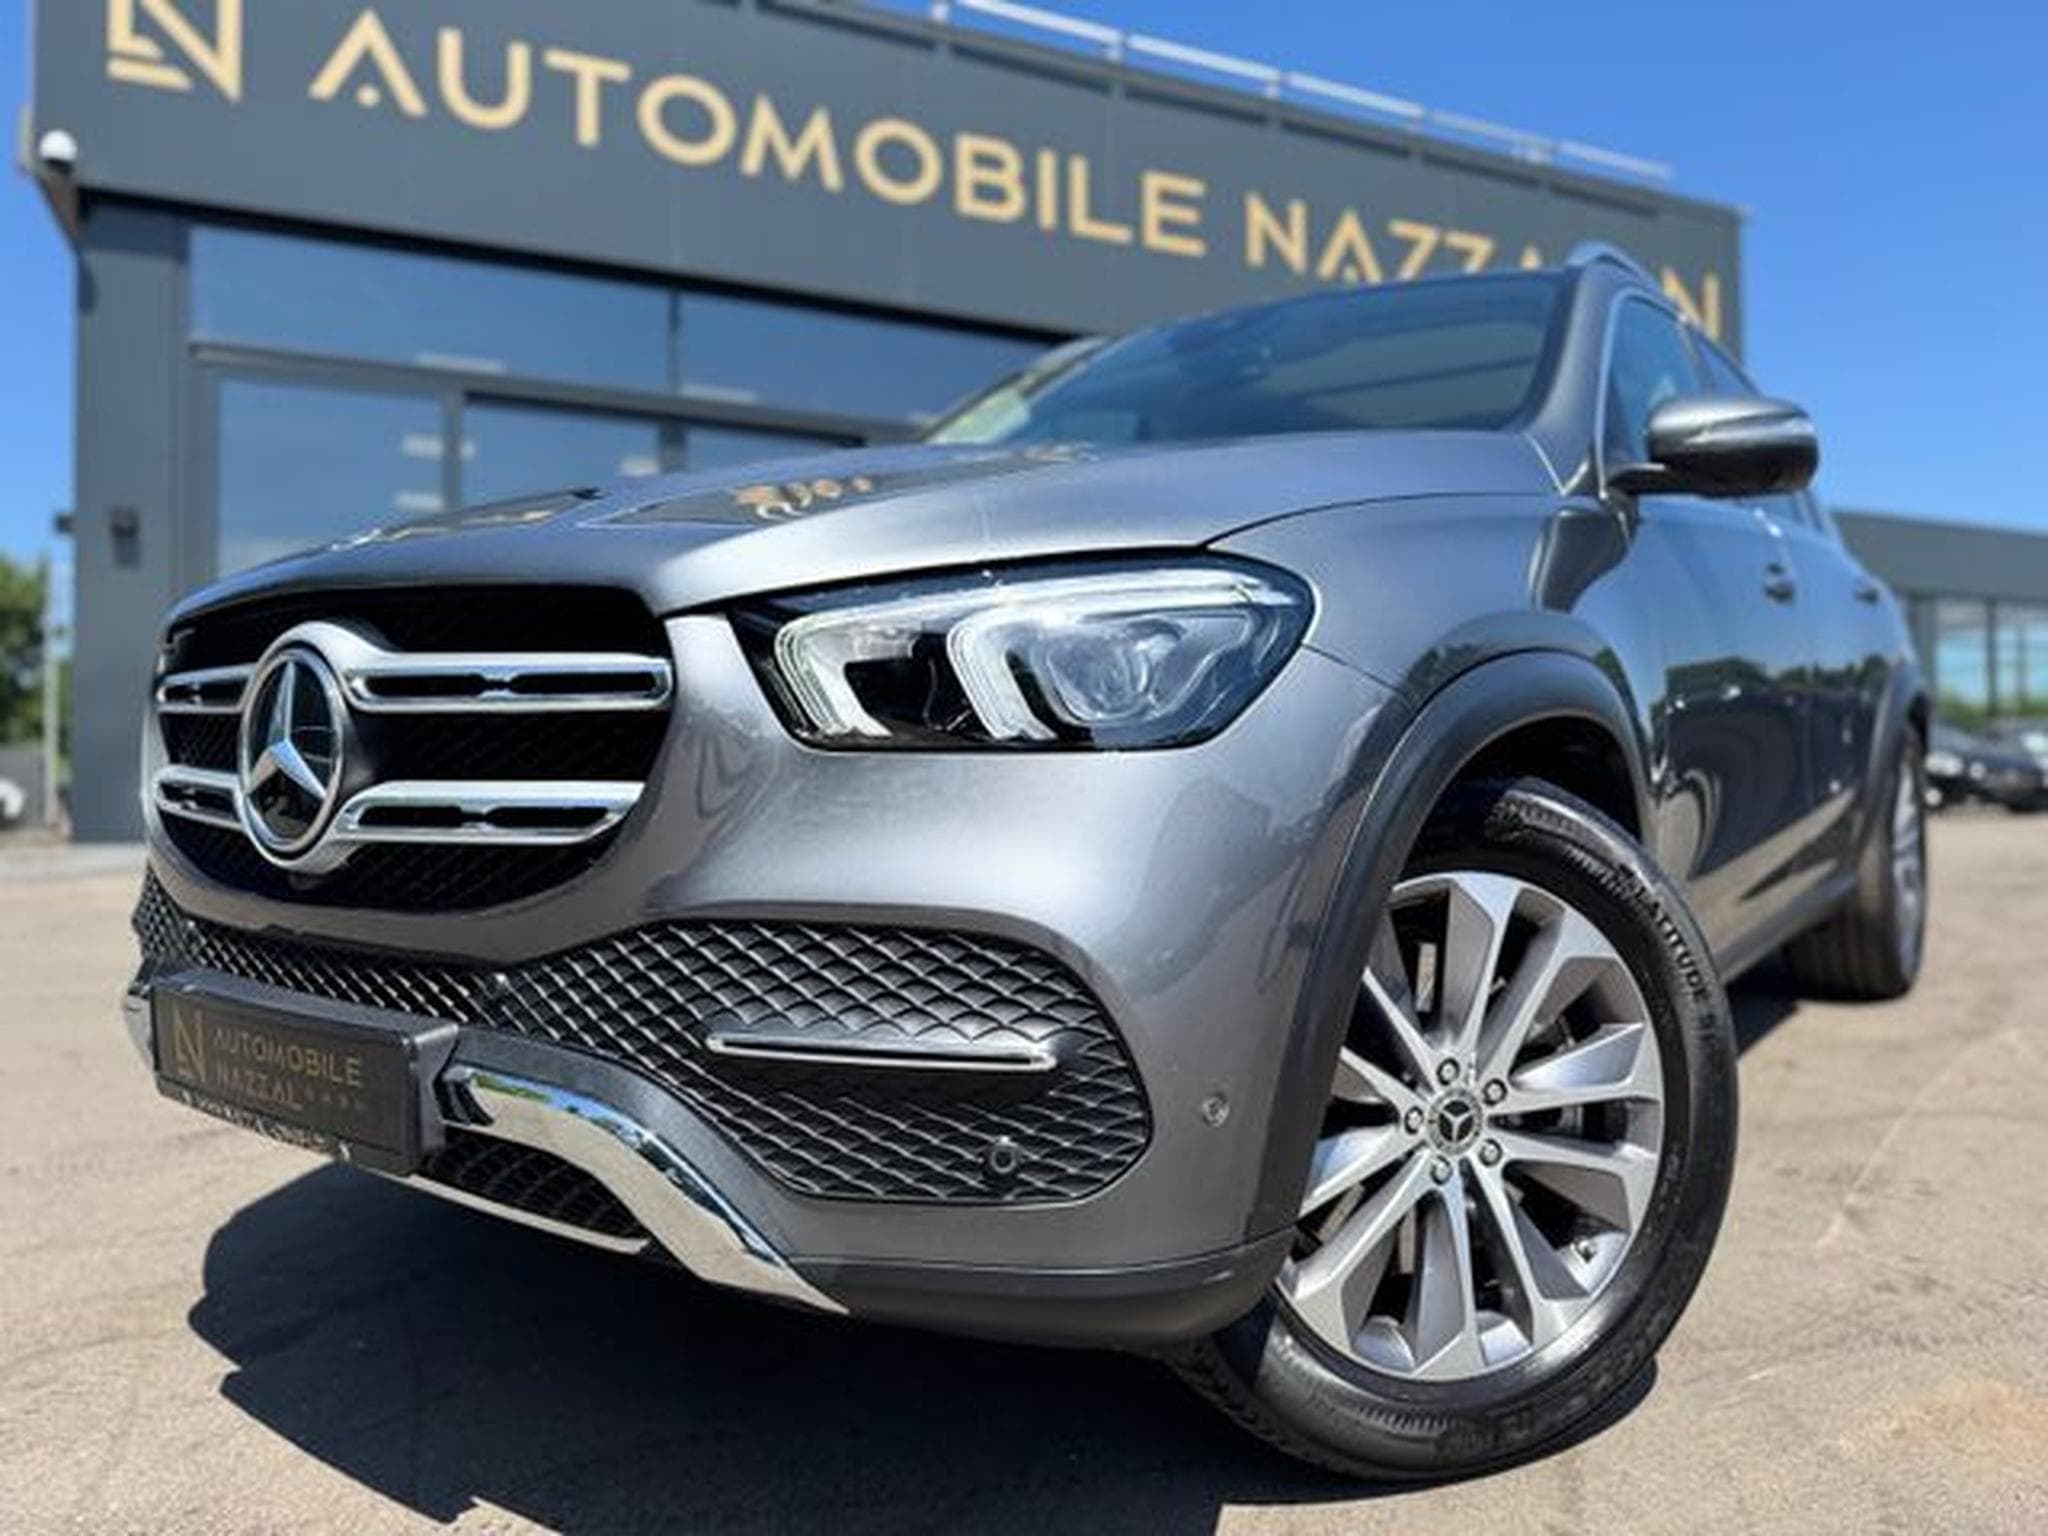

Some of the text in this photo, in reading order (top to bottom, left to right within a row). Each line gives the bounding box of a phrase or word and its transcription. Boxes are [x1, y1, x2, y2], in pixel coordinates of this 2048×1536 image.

[311, 11, 1206, 257] AUTOMOBILE
[1243, 192, 1542, 284] NAZZ
[213, 1028, 362, 1088] AUTOMOBILE
